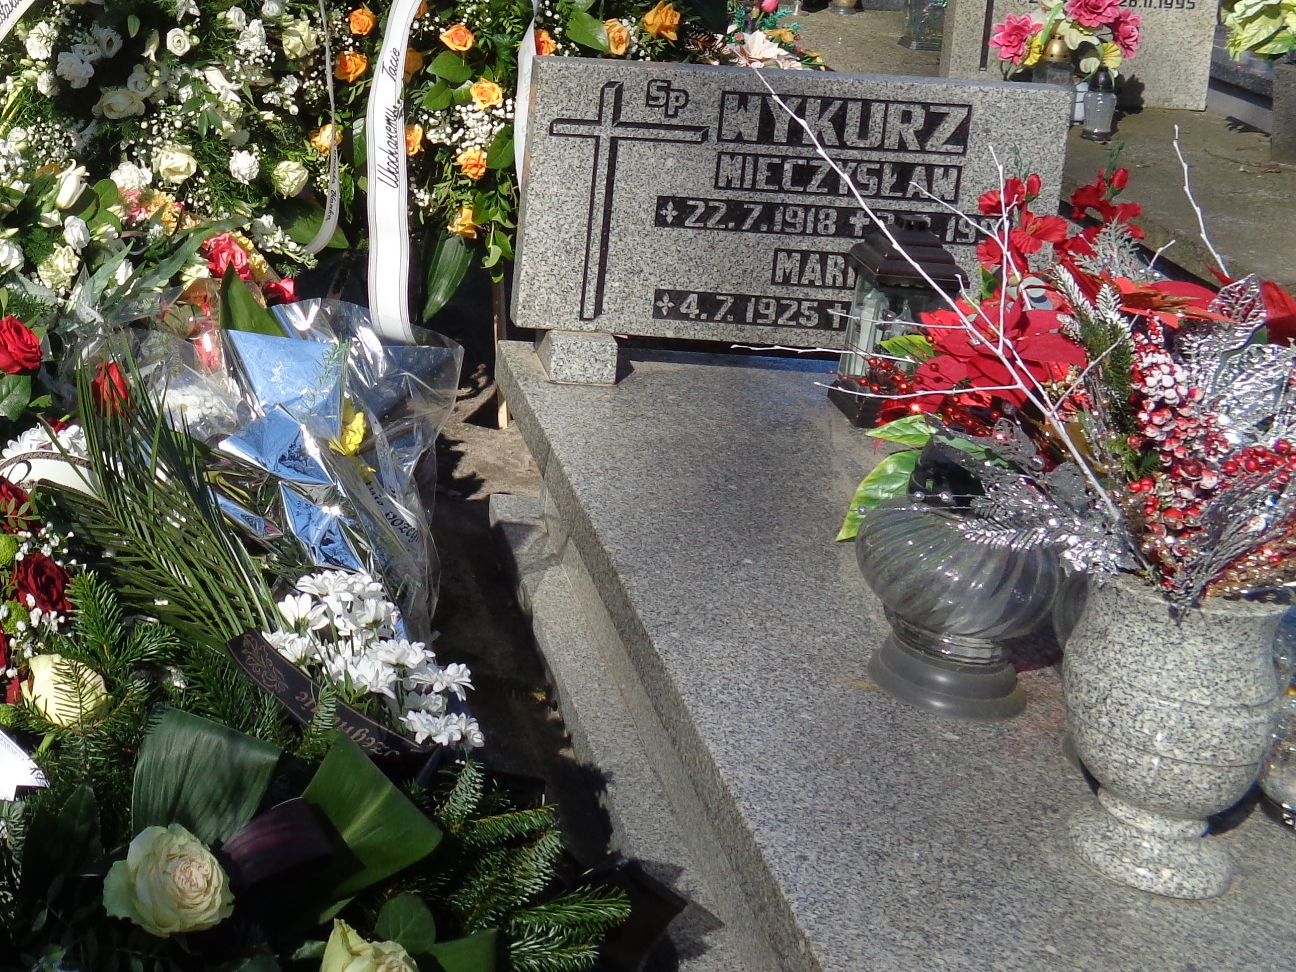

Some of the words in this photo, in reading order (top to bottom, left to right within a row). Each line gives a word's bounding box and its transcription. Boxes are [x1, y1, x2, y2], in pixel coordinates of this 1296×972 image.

[720, 91, 969, 154] WYKURZ
[715, 153, 959, 203] MIECZYSŁAW
[684, 200, 838, 236] 22.7.1918
[679, 293, 820, 328] 4.7.1925
